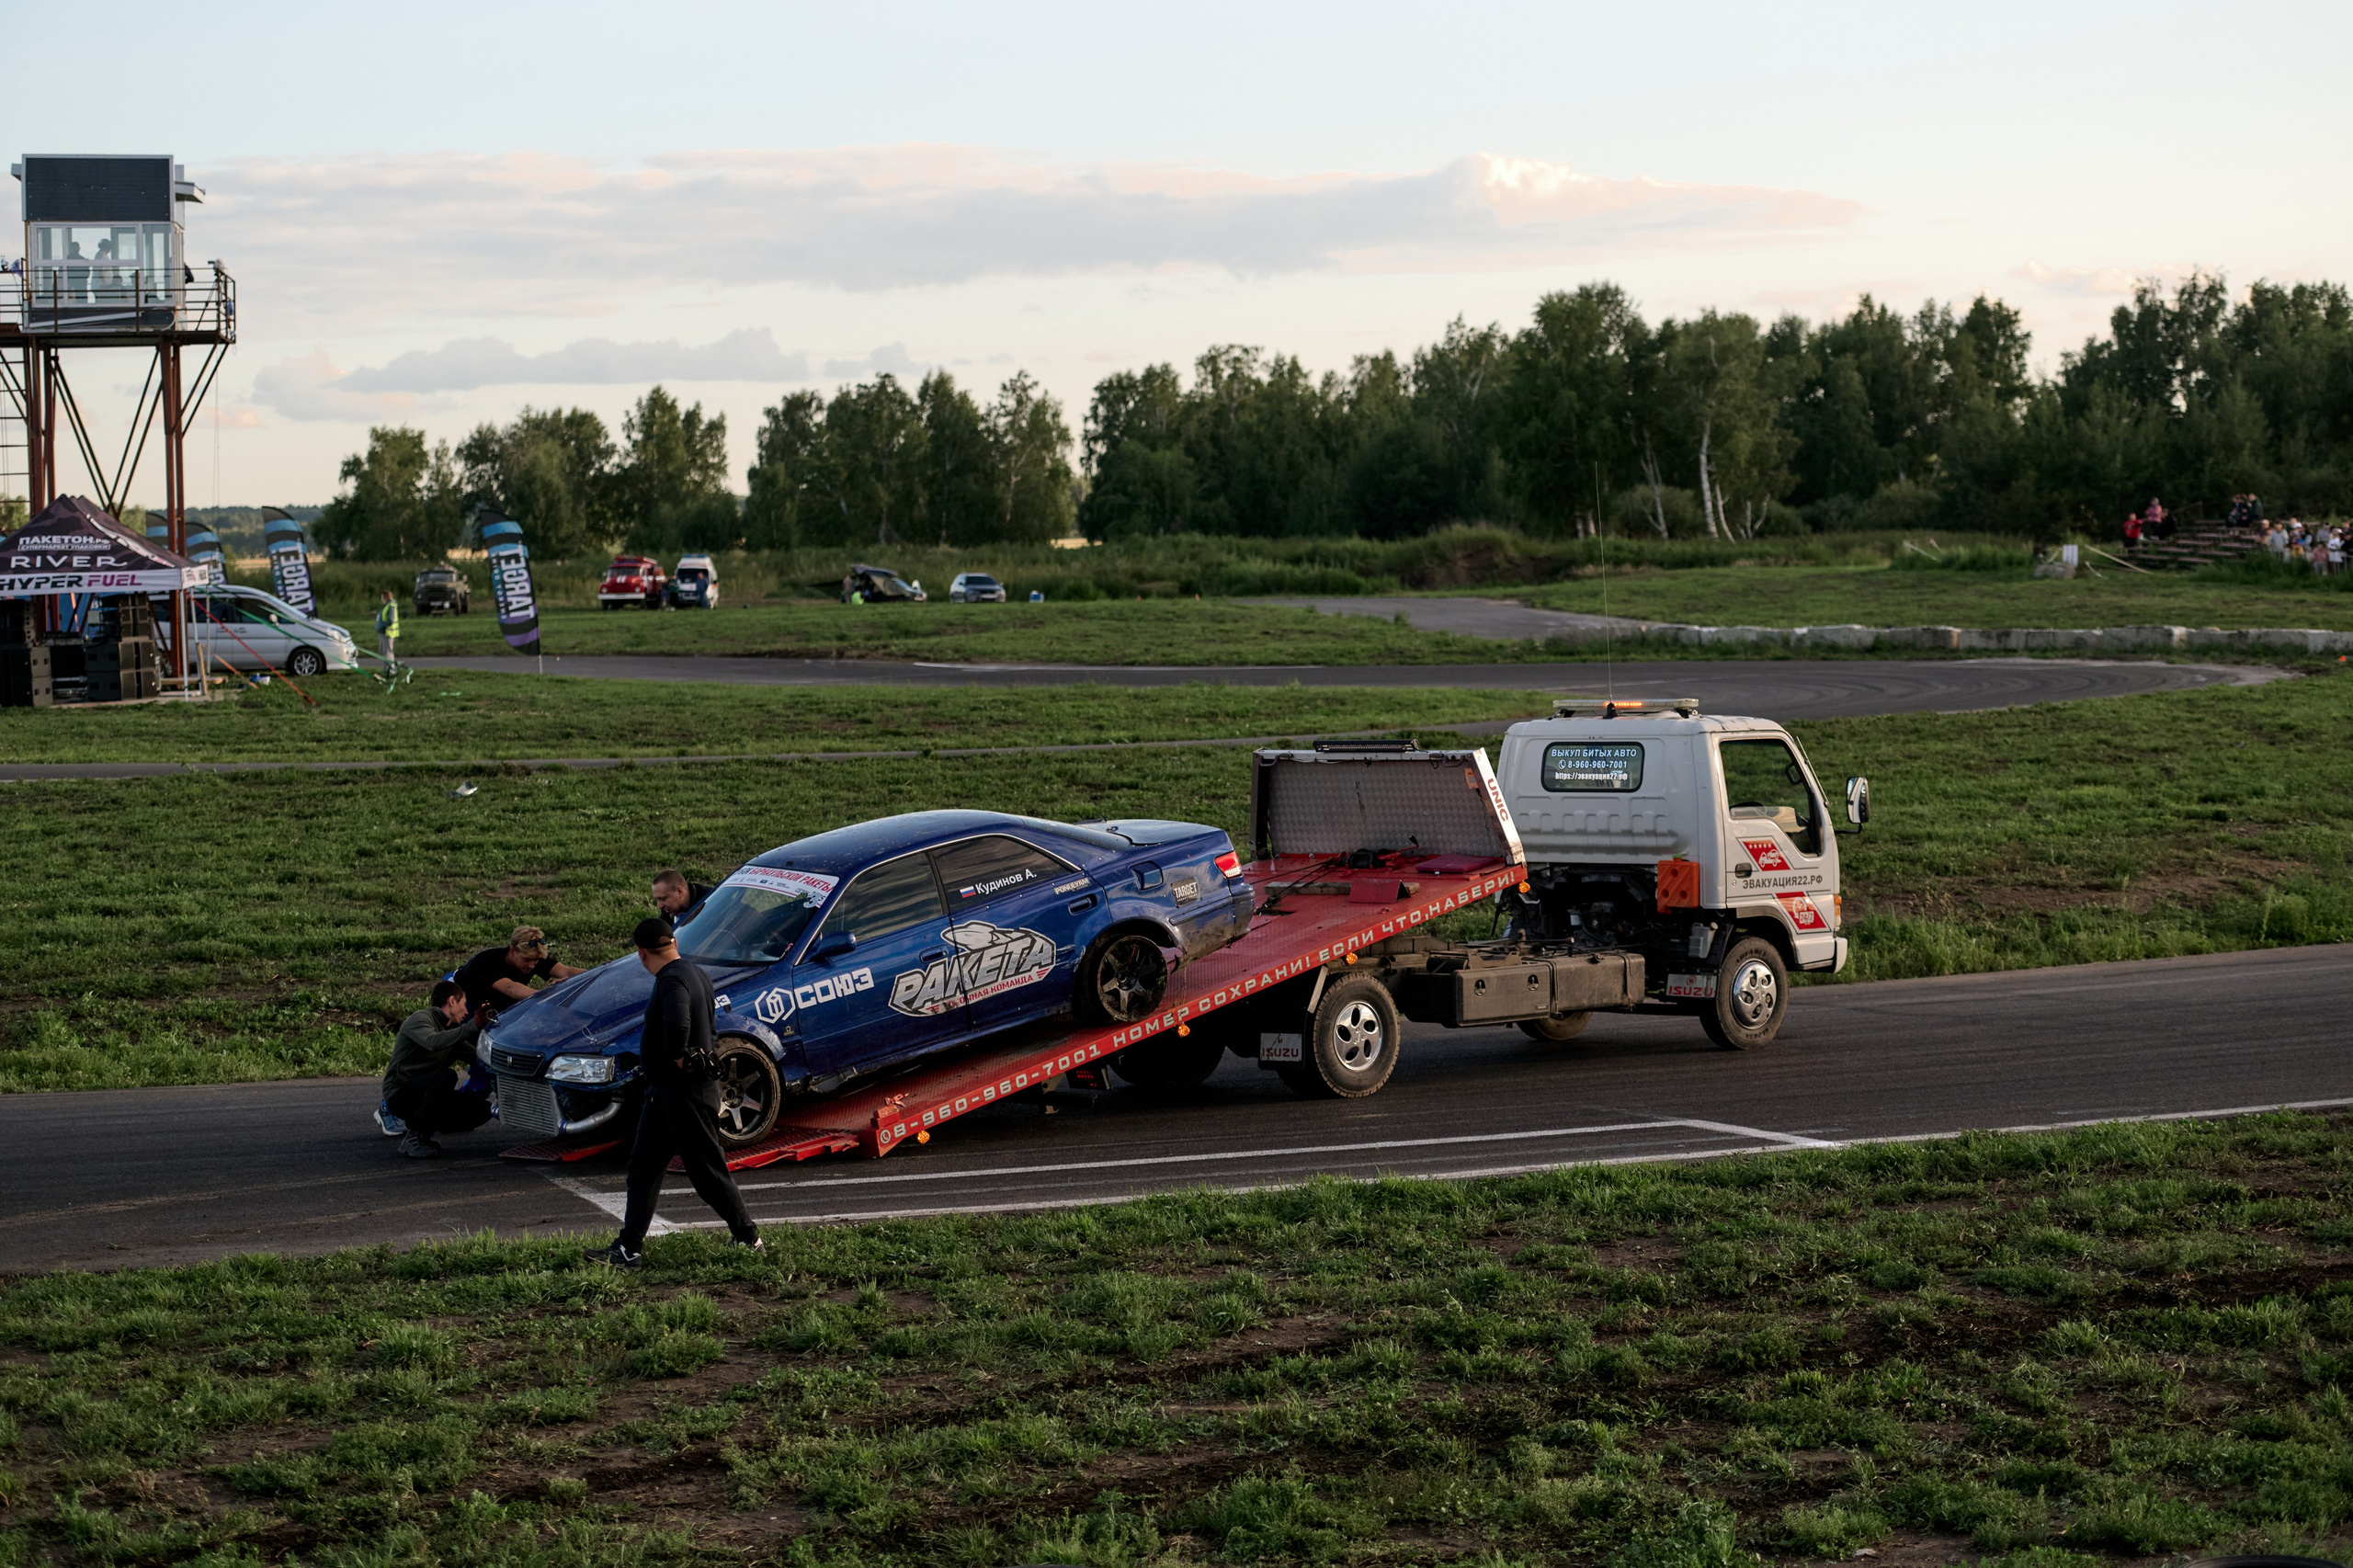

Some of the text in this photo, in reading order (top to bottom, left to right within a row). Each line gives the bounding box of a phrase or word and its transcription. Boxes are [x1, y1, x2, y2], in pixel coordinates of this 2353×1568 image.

[10, 555, 128, 568] RIVER
[0, 574, 142, 591] HYPER FUEL
[1551, 749, 1637, 757] ВЫКУП БИТЫХ АВТО
[1567, 760, 1628, 768] 8-960-960-7001
[1487, 778, 1509, 822] UNIC
[799, 876, 835, 893] РАКЕТЫ
[975, 868, 1037, 895] Кудинов А.
[1174, 881, 1198, 899] TARGET
[1743, 874, 1823, 890] ЭВАКУАЦИЯ22.РФ
[892, 935, 1054, 1011] РАКЕТА
[793, 967, 875, 1009] СОЮЗ
[991, 974, 1033, 994] КОМАНДА
[1668, 985, 1714, 997] ISUZU
[893, 1044, 1101, 1138] 8-960-960-7001
[1112, 1006, 1189, 1049] НОМЕР
[1199, 957, 1311, 1012] СОХРАНИ!
[1318, 929, 1375, 962] ЕСЛИ
[1262, 1048, 1299, 1057] ISUZU
